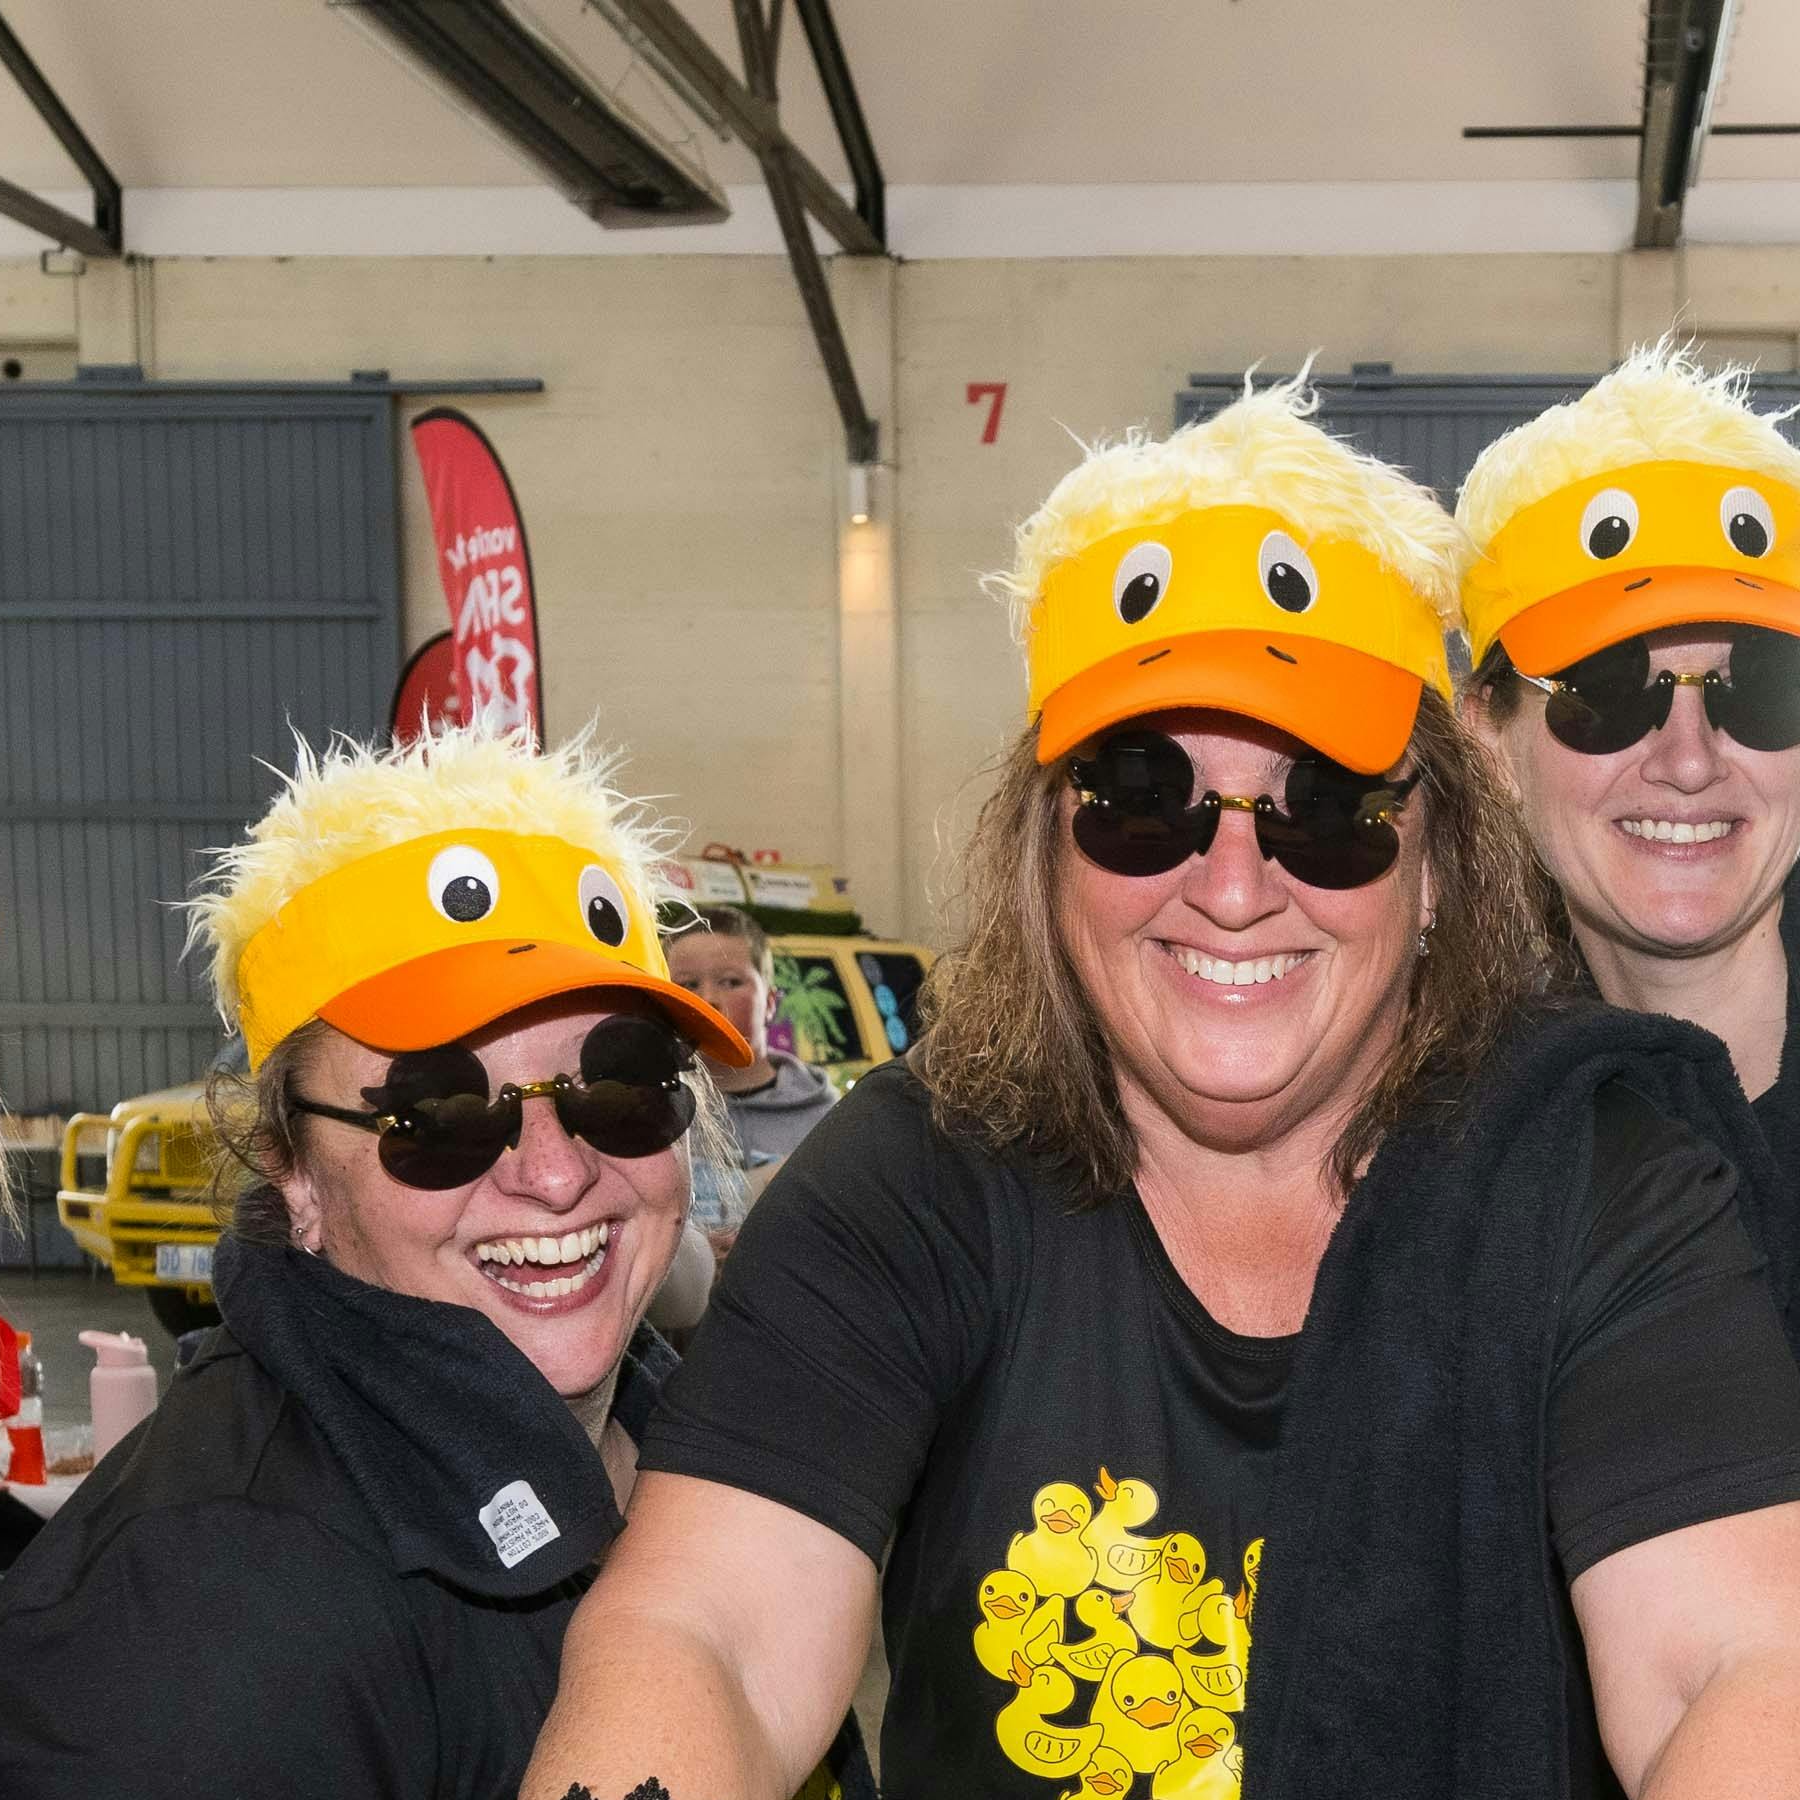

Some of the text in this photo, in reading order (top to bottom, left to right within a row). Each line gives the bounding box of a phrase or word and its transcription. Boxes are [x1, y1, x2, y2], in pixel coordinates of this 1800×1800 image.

[966, 382, 1008, 444] 7
[504, 1513, 522, 1528] WASH
[507, 1539, 531, 1558] COTTON
